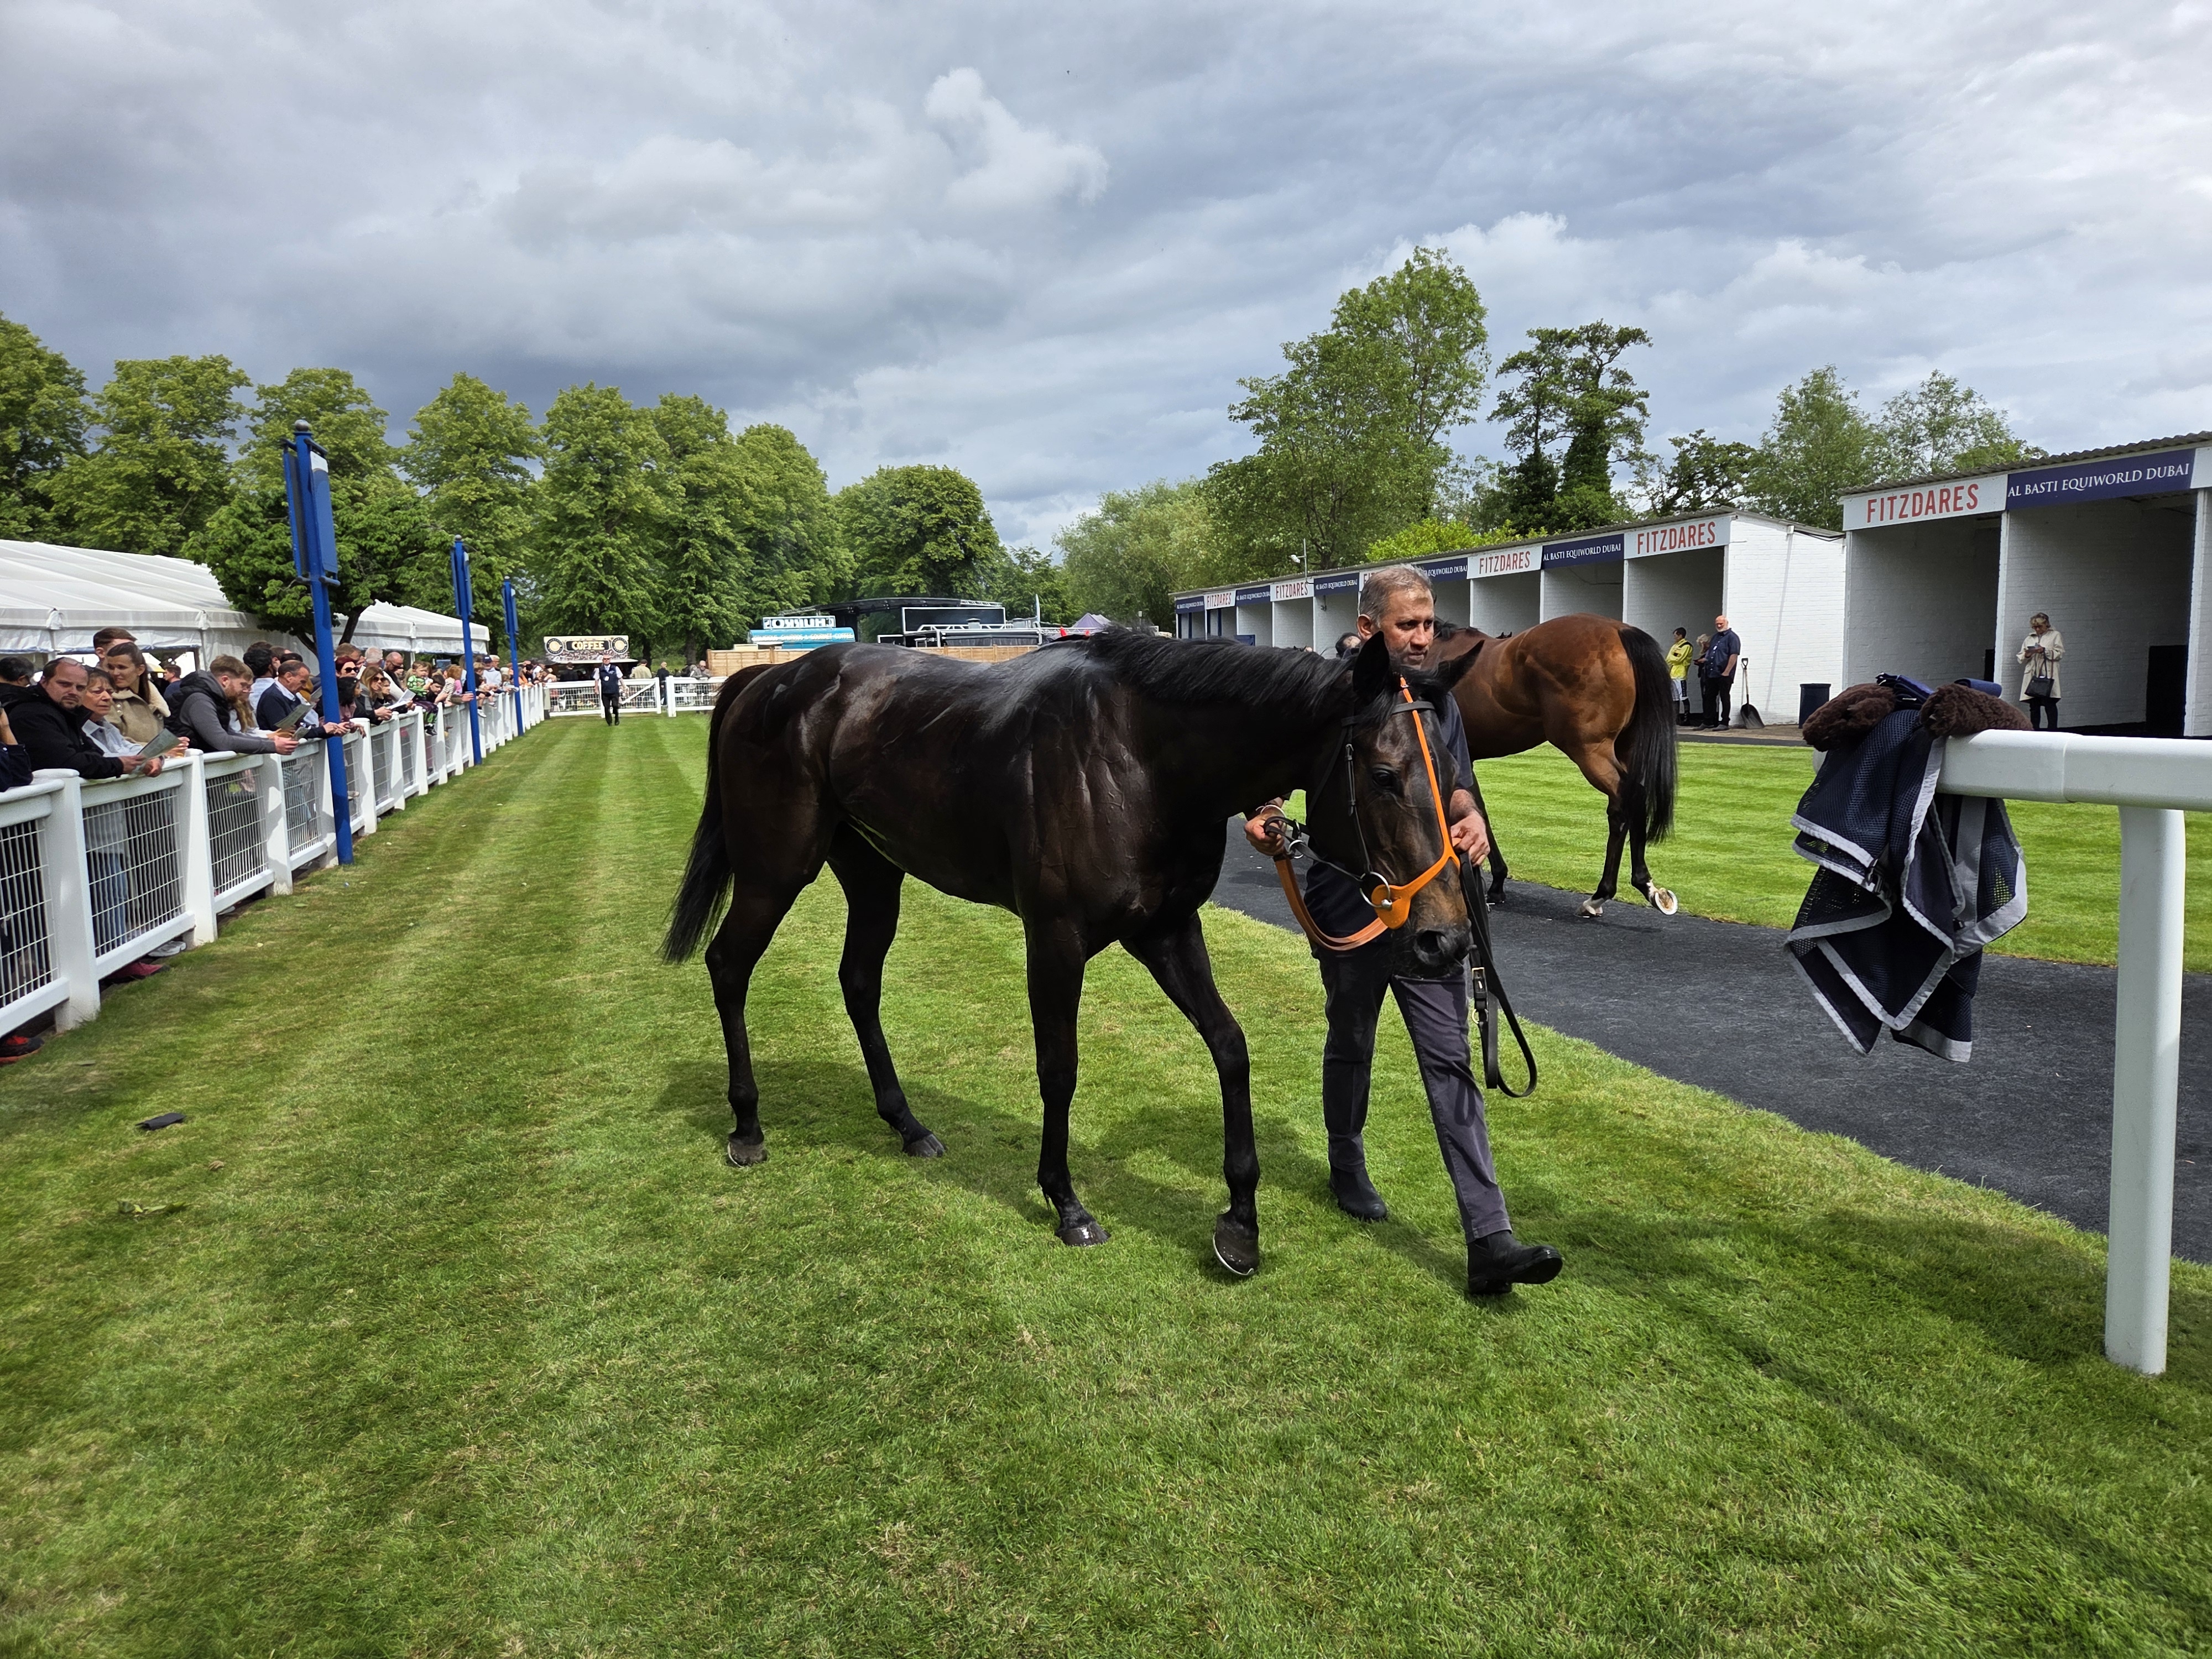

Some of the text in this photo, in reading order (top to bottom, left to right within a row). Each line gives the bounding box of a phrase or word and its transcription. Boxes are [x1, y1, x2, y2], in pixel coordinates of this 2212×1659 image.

[2007, 463, 2189, 497] AL BASTI EQUIWORLD DUBAI
[1867, 483, 1979, 523] FITZDARES
[1637, 521, 1715, 554] FITZDARES
[1550, 551, 1564, 560] BASTI
[1566, 546, 1601, 559] EQUIWORLD
[1602, 543, 1621, 553] DUBAI
[1479, 551, 1531, 574] FITZDARES
[1207, 592, 1232, 608] FITZDARES
[1276, 582, 1308, 599] FITZDARES
[571, 641, 605, 650] COFFEE
